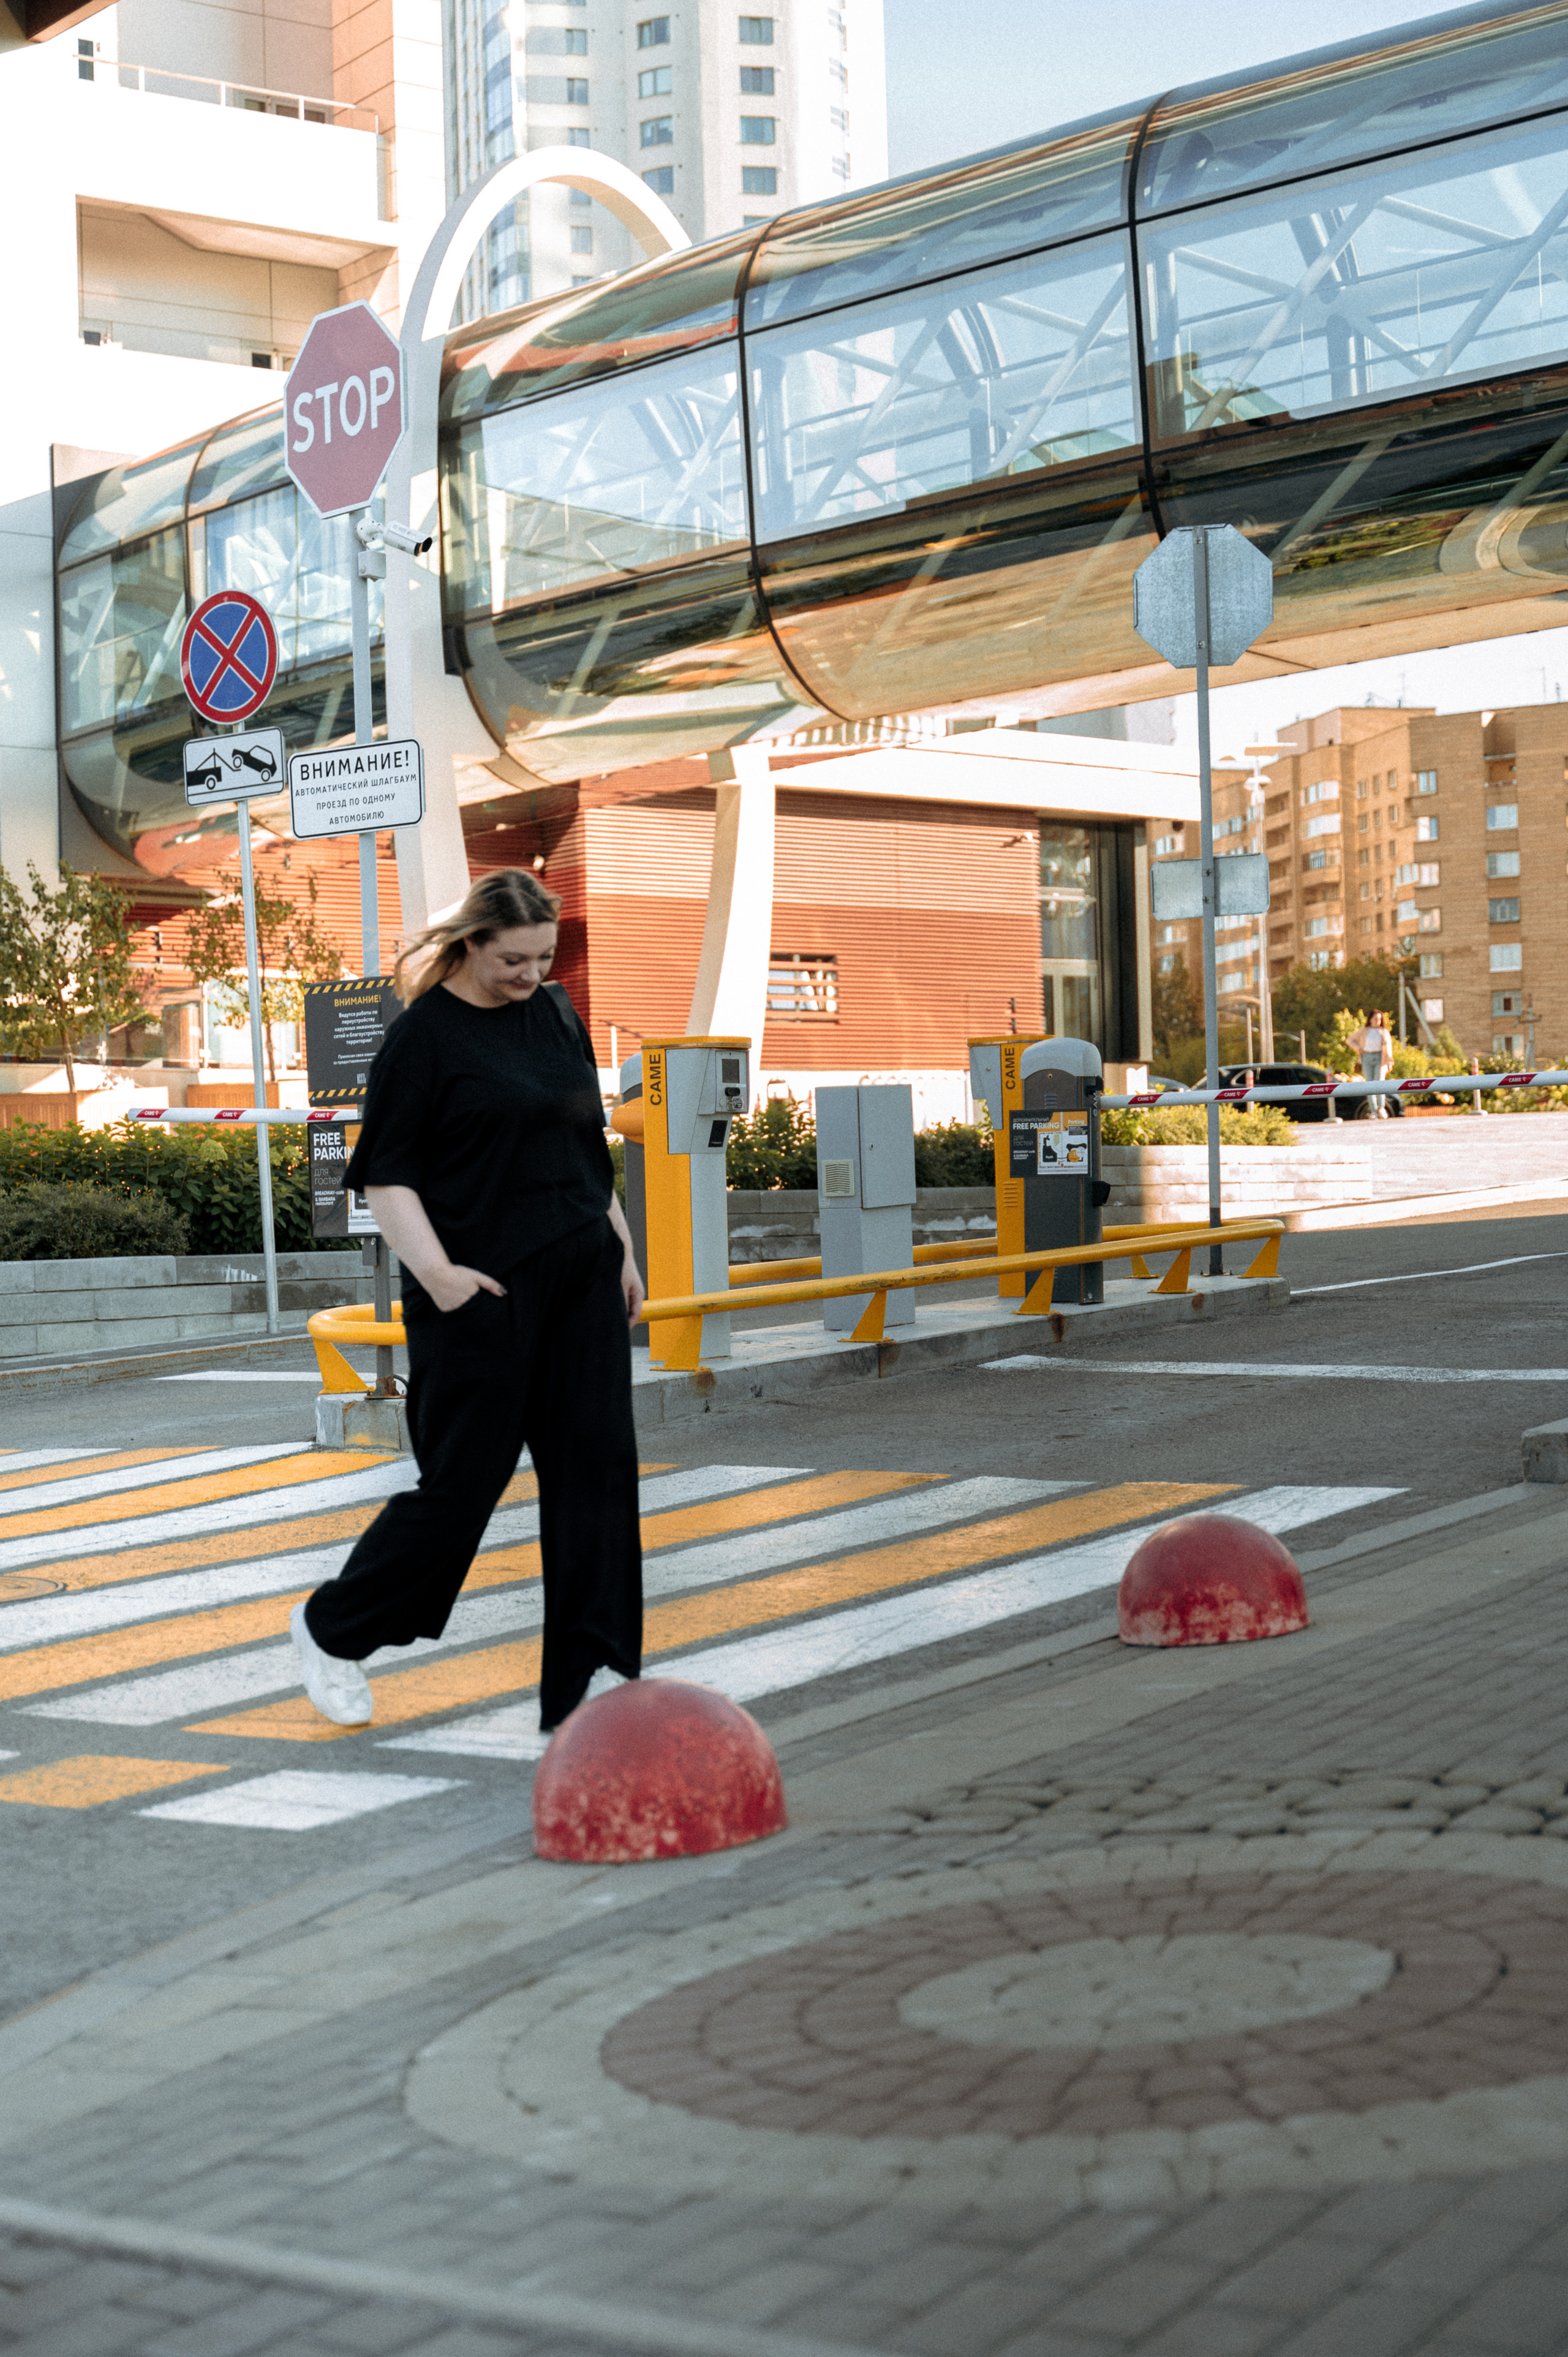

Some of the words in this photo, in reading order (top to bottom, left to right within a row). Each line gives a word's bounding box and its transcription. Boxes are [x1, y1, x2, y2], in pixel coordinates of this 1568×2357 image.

[292, 366, 395, 453] STOP
[300, 749, 409, 781] ВНИМАНИЕ!
[295, 780, 369, 796] АВТОМАТИЧЕСКИЙ
[371, 774, 417, 787] ШЛАГБАУМ
[316, 799, 347, 811] ПРОЕЗД
[349, 798, 360, 806] ПО
[363, 793, 396, 805] ОДНОМУ
[329, 811, 385, 825] АВТОМОБИЛЮ
[334, 994, 382, 1007] ВНИМАНИЕ!
[1005, 1047, 1016, 1090] CAME
[649, 1053, 662, 1105] CAME
[314, 1132, 341, 1146] FREE
[314, 1146, 355, 1160] PARKIN
[314, 1168, 329, 1177] для
[314, 1176, 342, 1185] гостей
